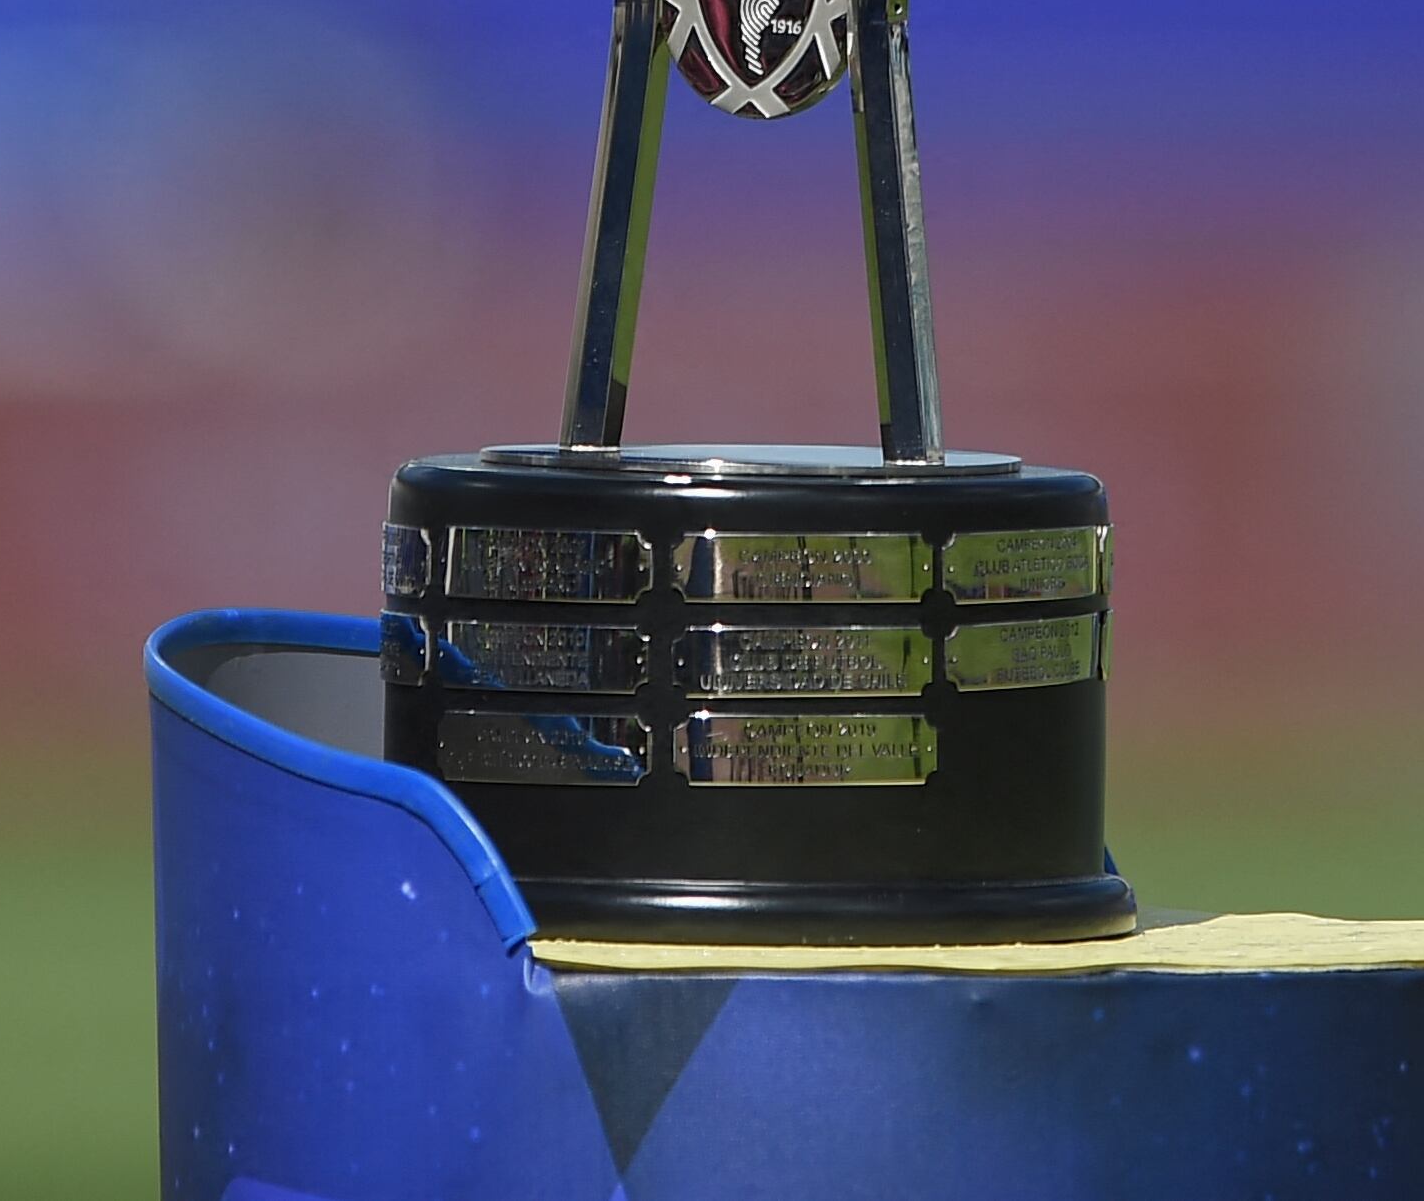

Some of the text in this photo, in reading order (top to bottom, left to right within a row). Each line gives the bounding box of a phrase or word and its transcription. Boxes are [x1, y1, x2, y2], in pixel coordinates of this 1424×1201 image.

[770, 19, 803, 35] 1916
[975, 558, 1011, 578] CLUB
[1000, 626, 1057, 643] CAMPEON
[700, 672, 909, 691] UNIVERSIDAD DE CHILE
[743, 723, 878, 740] CAMPEON 2019
[693, 742, 920, 760] INDEPENDIENTE DEL VALLE
